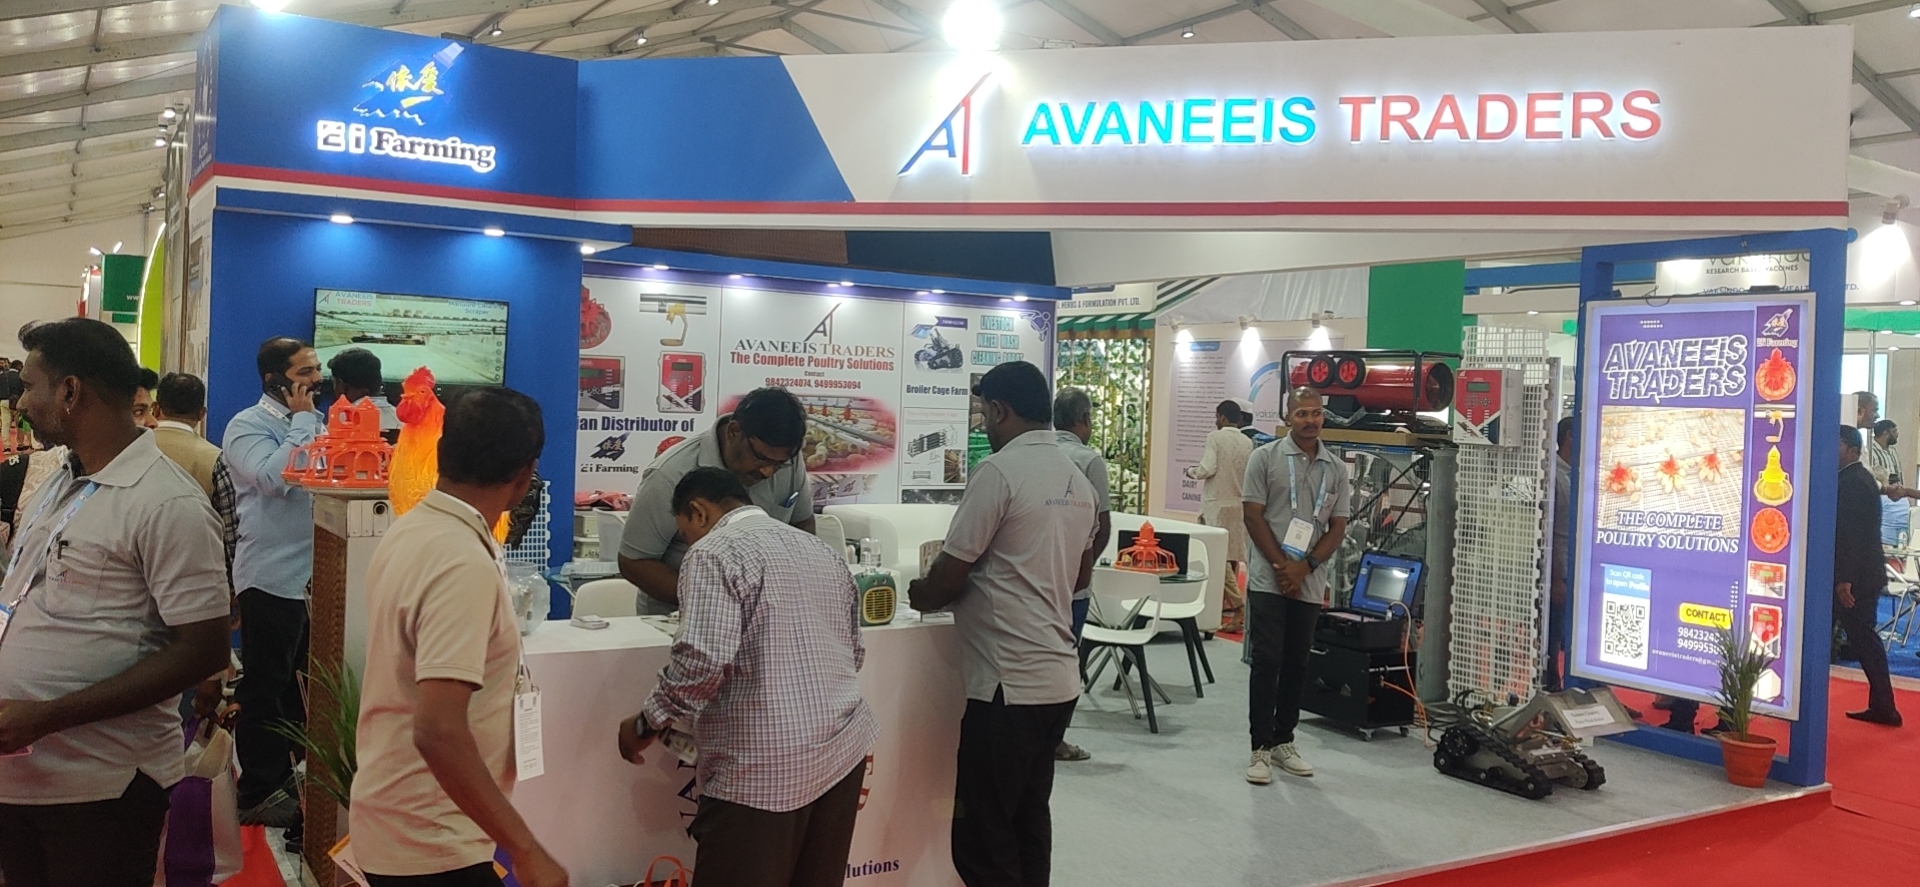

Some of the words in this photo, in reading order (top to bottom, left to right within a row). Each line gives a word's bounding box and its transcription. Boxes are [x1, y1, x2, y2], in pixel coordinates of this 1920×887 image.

[1022, 96, 1316, 146] AVANEEIS
[1340, 90, 1663, 143] TRADERS
[373, 128, 495, 170] Farming
[337, 298, 372, 306] TRADERS
[465, 308, 490, 316] Scraper
[734, 338, 818, 354] AVANEEIS
[820, 343, 895, 359] TRADERS
[1602, 334, 1749, 373] AVANEEIS
[730, 351, 750, 364] The
[753, 352, 805, 367] Complete
[807, 355, 845, 370] Poultry
[847, 358, 895, 371] Solutions
[906, 384, 931, 395] Broiler
[932, 385, 950, 396] Cage
[951, 386, 969, 396] Farm
[1606, 364, 1748, 402] TRADERS
[577, 416, 598, 431] ian
[601, 416, 679, 432] Distributor
[681, 418, 695, 432] of
[595, 464, 639, 475] Farming
[1182, 480, 1198, 489] DAIRY
[1617, 510, 1646, 527] THE
[1646, 511, 1723, 531] COMPLETE
[1595, 531, 1654, 548] POULTRY
[1657, 535, 1740, 554] SOLUTIONS
[1610, 569, 1622, 577] Scan
[1623, 570, 1631, 579] QR
[1685, 608, 1727, 623] CONTACT
[846, 859, 900, 879] lutions
